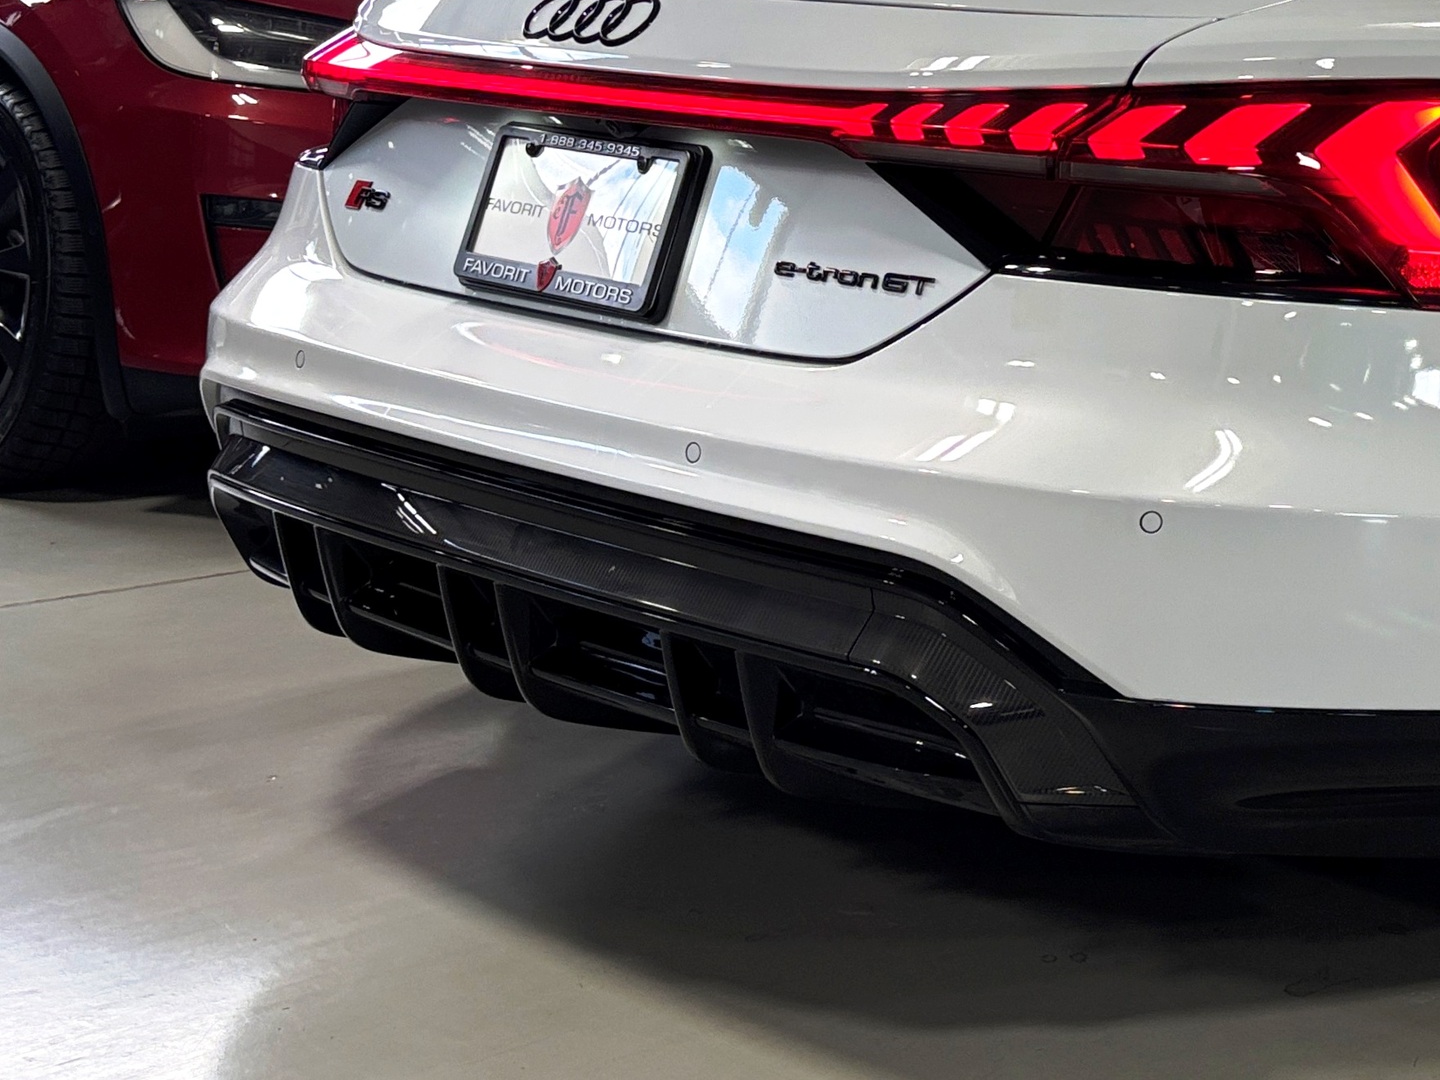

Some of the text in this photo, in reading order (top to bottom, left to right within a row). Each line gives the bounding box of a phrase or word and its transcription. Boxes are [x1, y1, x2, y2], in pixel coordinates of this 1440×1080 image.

[345, 180, 391, 211] RS
[588, 213, 662, 238] MOTORS
[463, 258, 633, 305] FAVORIT MOTORS
